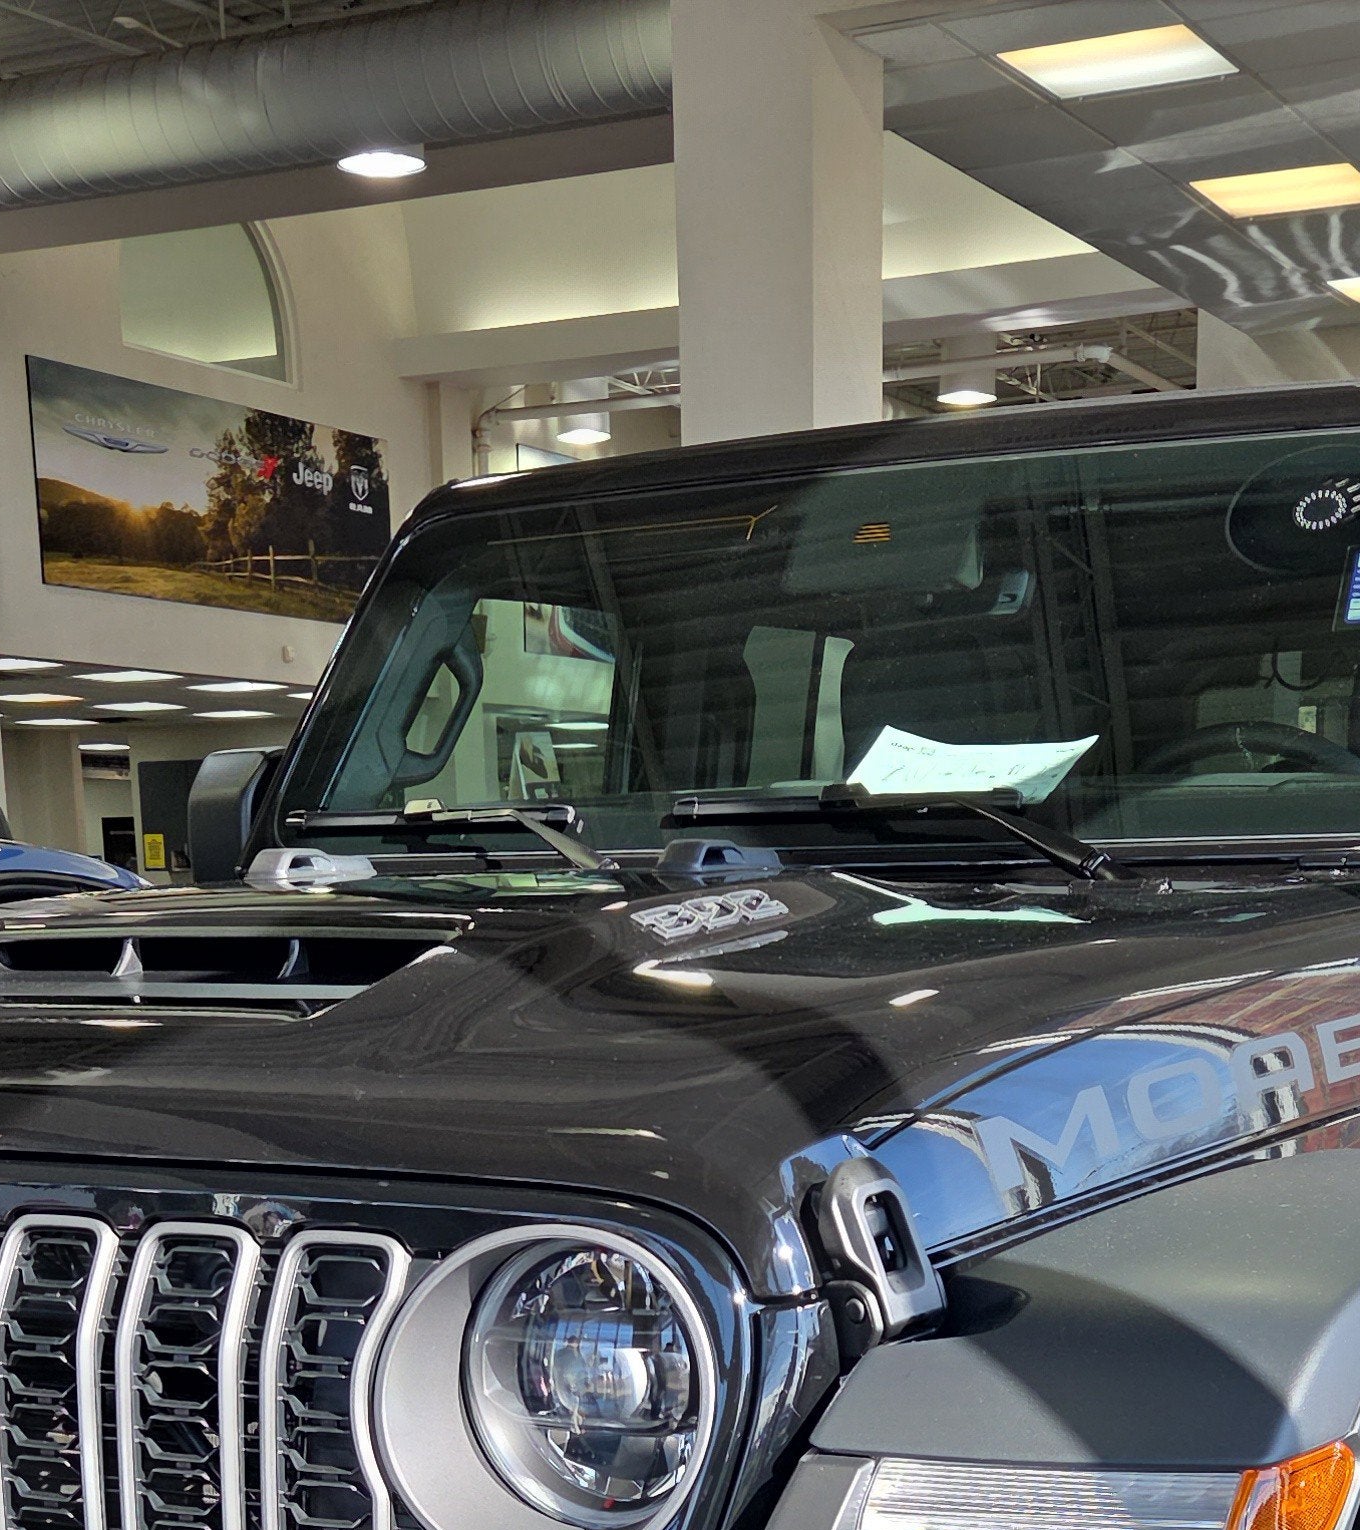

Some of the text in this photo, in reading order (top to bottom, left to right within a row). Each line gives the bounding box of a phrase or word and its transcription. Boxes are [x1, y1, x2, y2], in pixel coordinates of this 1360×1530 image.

[74, 412, 157, 438] CHRYSLER
[292, 461, 334, 496] Jeep
[348, 502, 374, 515] RAM
